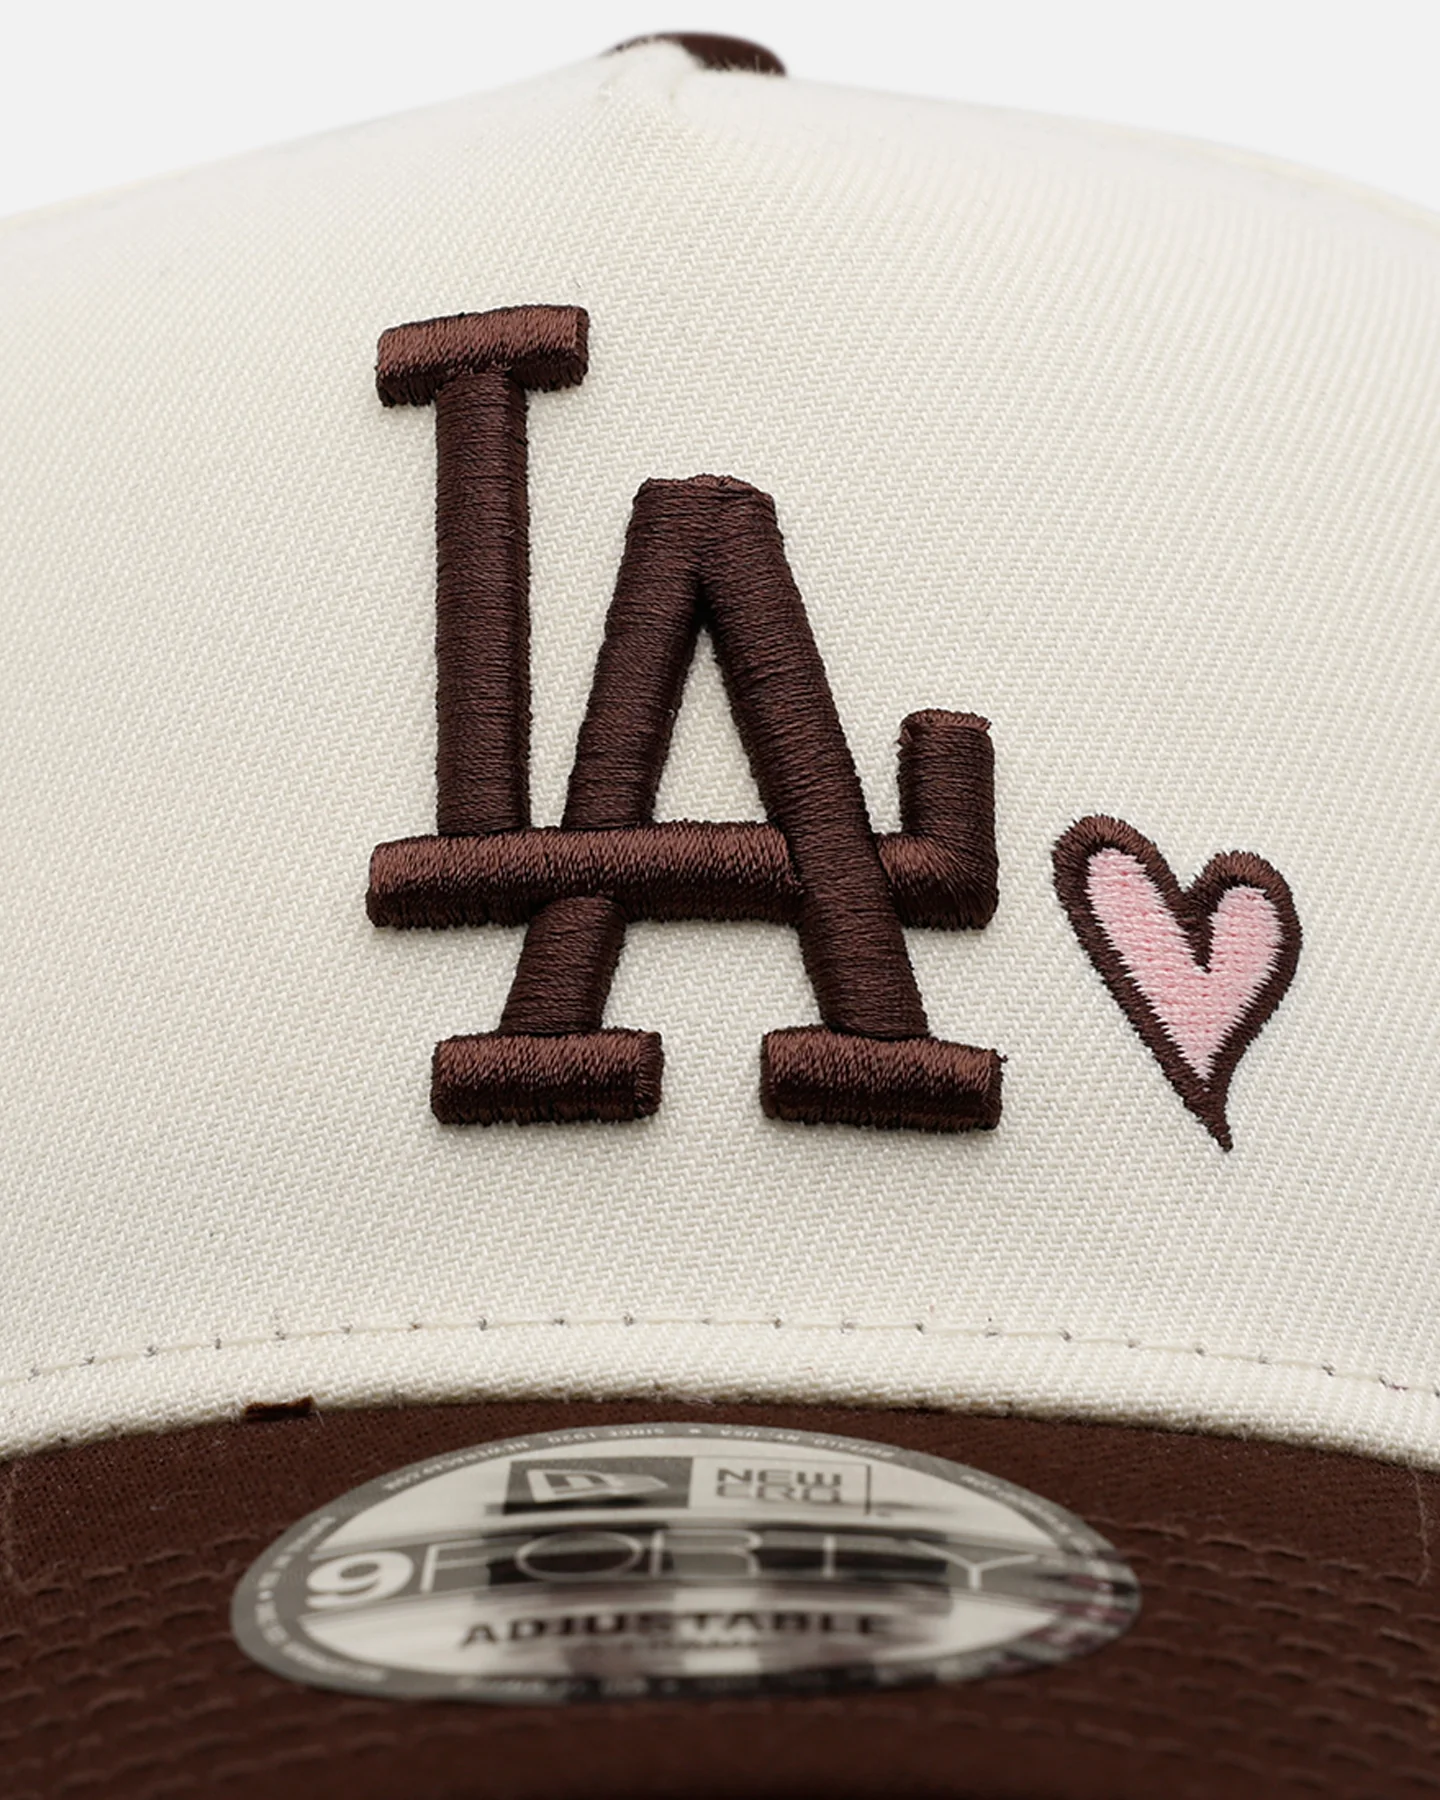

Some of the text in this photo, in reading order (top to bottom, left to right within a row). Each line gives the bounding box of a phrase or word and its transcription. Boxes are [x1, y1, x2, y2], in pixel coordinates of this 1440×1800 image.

[366, 304, 1003, 1130] LA
[548, 1425, 666, 1445] SINCE 1920
[717, 1468, 842, 1487] NEW
[304, 1527, 1037, 1609] 9FORTY
[459, 1609, 895, 1649] ADJUSTABLE
